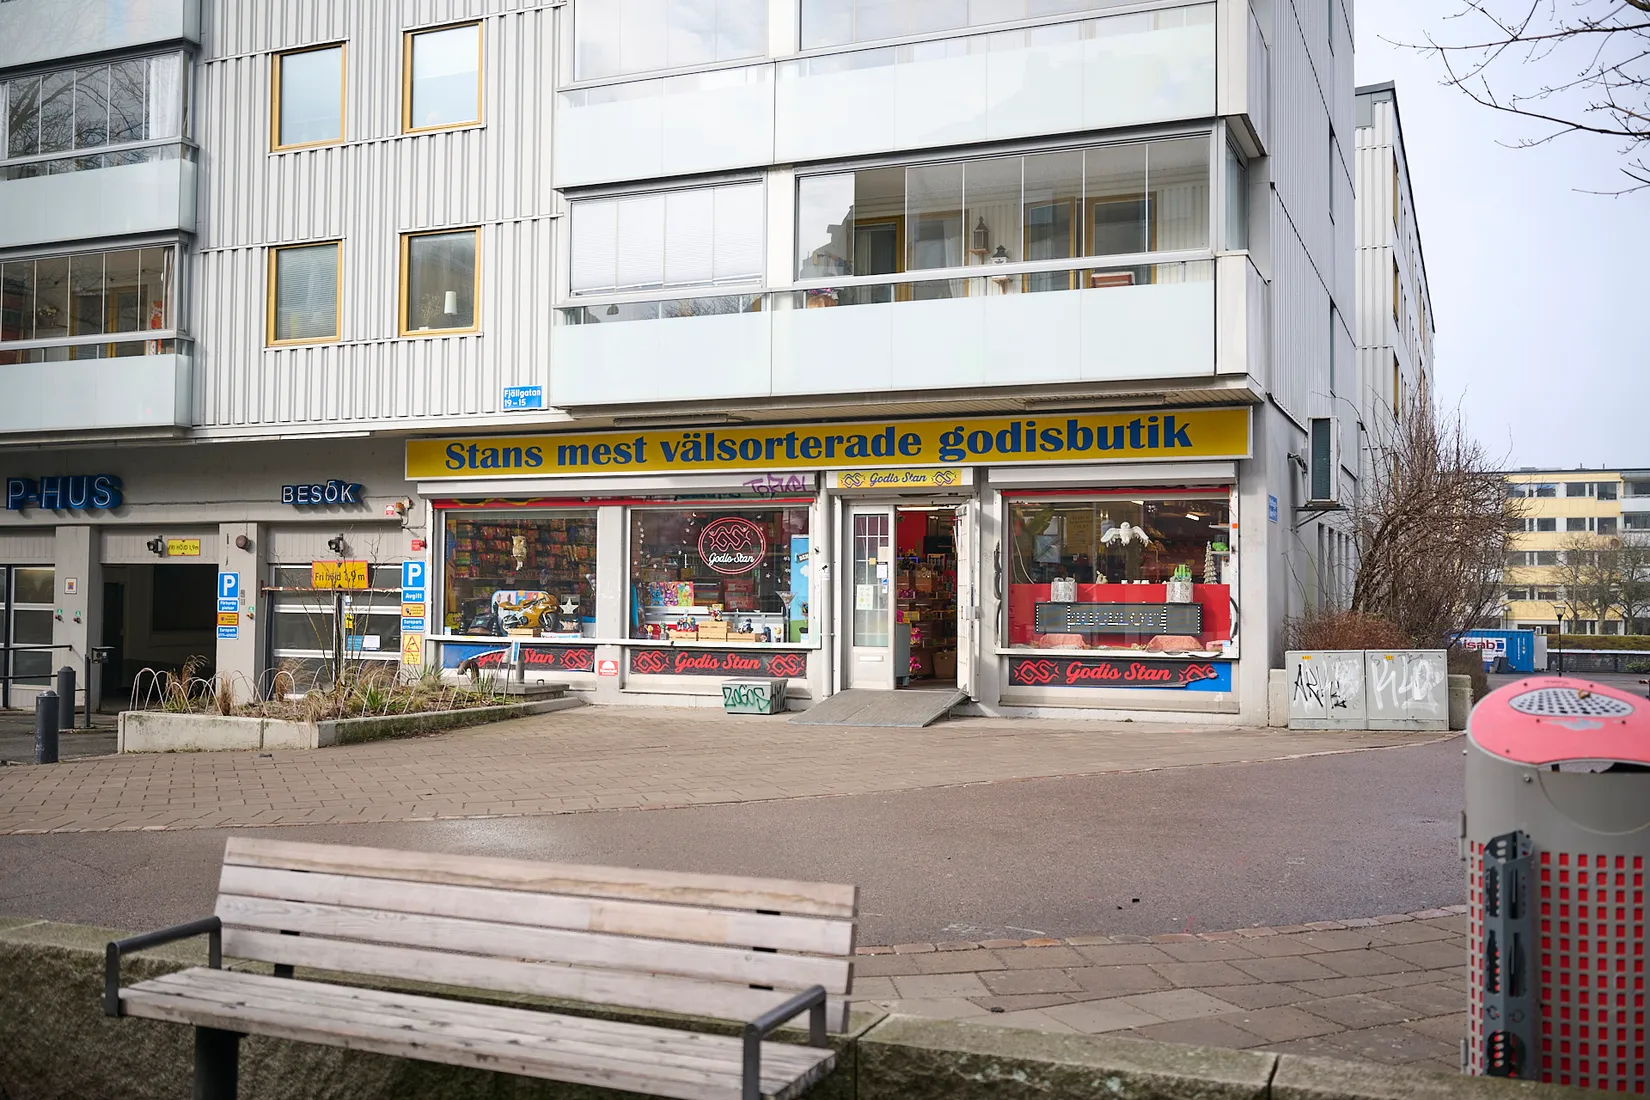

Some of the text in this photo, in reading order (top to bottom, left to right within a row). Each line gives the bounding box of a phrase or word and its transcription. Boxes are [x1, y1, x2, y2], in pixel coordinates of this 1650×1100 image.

[504, 389, 541, 399] Fjällgatan
[504, 399, 512, 407] 19
[518, 398, 527, 406] 15
[445, 415, 1193, 470] Stans mest välsorterade godisbutik
[870, 472, 900, 487] Godis
[902, 472, 927, 483] Stan
[8, 476, 114, 508] P-HUS
[282, 480, 356, 504] BESÖK
[708, 552, 754, 566] Godis Stan
[315, 572, 324, 581] Fri
[408, 563, 422, 586] P
[223, 574, 236, 596] P
[405, 593, 423, 601] Avgift
[524, 648, 555, 665] Stan
[675, 652, 720, 674] Godis
[722, 653, 760, 670] Stan
[1066, 661, 1121, 685] Godis
[1124, 662, 1171, 681] Stan
